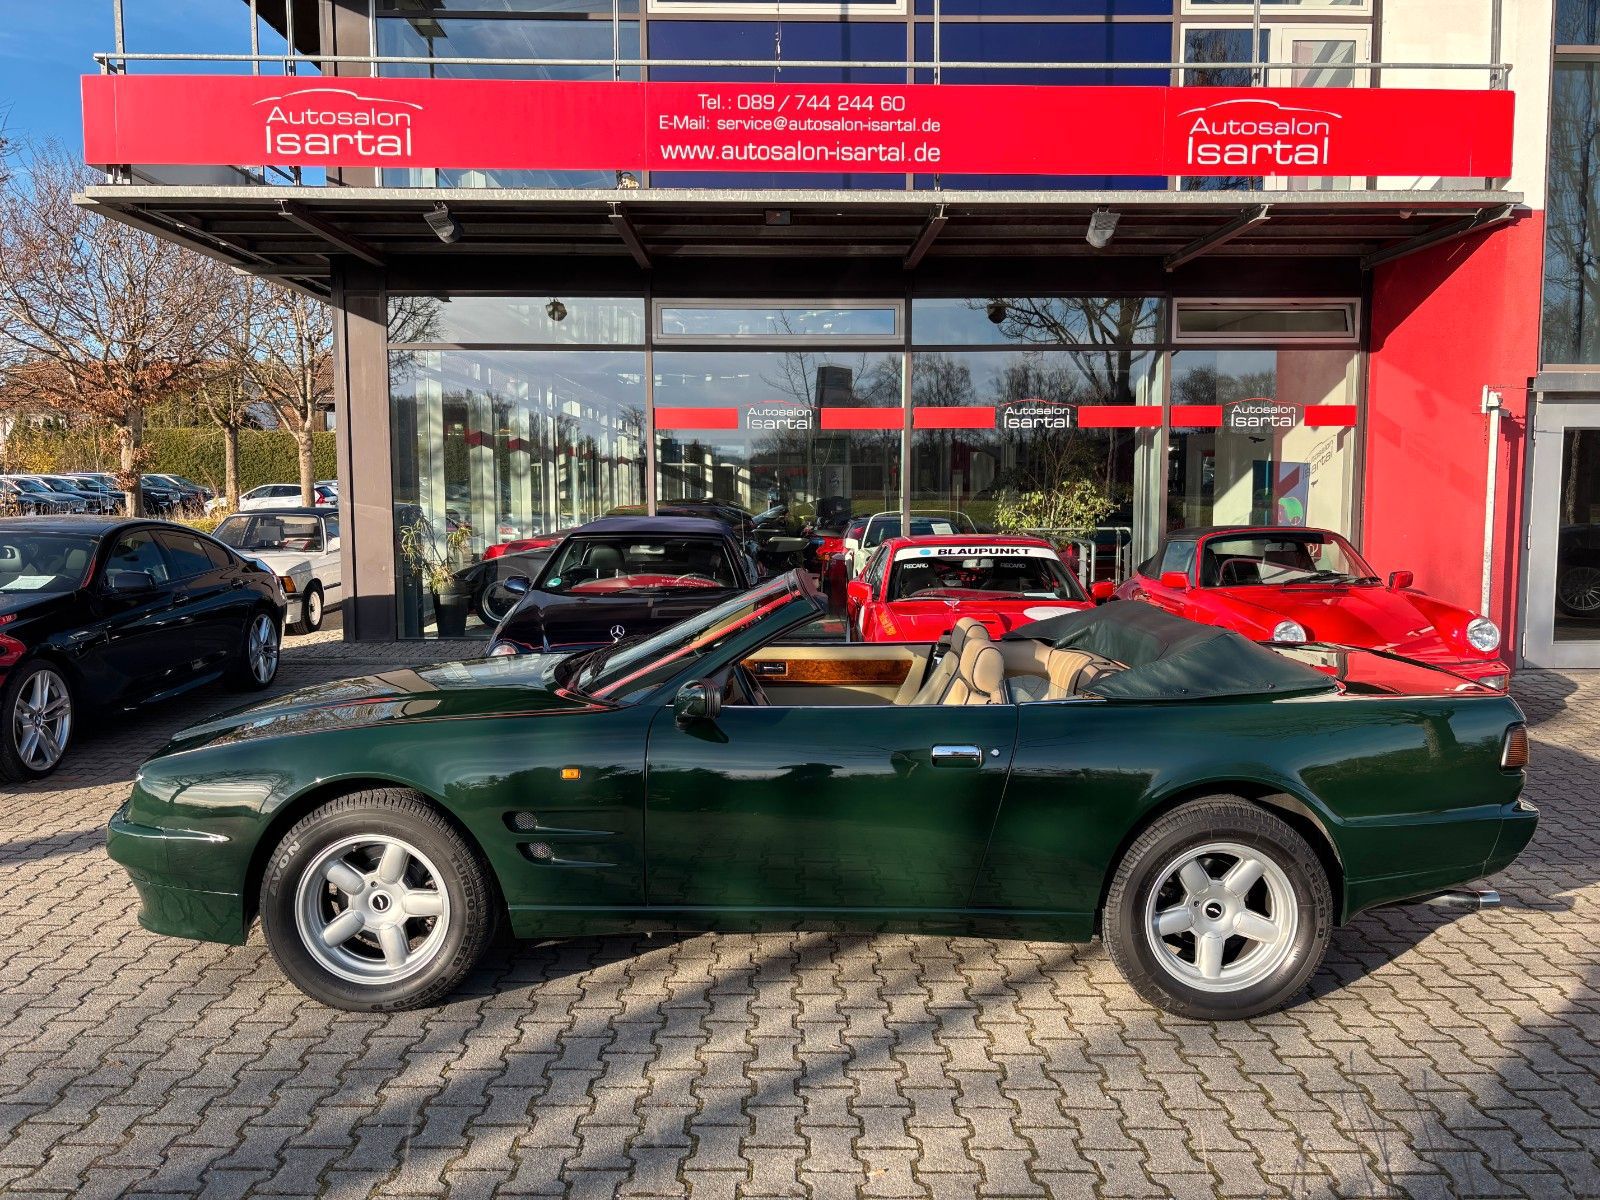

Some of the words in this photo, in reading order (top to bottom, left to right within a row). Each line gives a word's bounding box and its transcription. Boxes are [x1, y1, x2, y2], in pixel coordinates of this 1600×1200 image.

[698, 94, 732, 110] Tel.:
[737, 95, 775, 110] 089
[794, 95, 831, 110] 744
[837, 96, 874, 111] 244
[880, 96, 905, 111] 60
[266, 106, 411, 126] Autosalon
[659, 115, 710, 130] E-Mail:
[717, 116, 941, 133] service@autosalon-isartal.de
[1189, 117, 1330, 136] Autosalon
[265, 126, 412, 156] Isartal
[660, 141, 941, 162] www.autosalon-isartal.de
[1187, 136, 1329, 165] Isartal
[748, 407, 812, 417] Autosalon
[1004, 406, 1070, 415] Autosalon
[1231, 405, 1296, 414] Autosalon
[746, 416, 812, 430] Isartal
[1003, 414, 1070, 429] Isartal
[1230, 413, 1296, 427] Isartal
[937, 548, 1030, 556] BLAUPUNKT
[903, 562, 929, 570] RECARO
[269, 840, 301, 897] AVON
